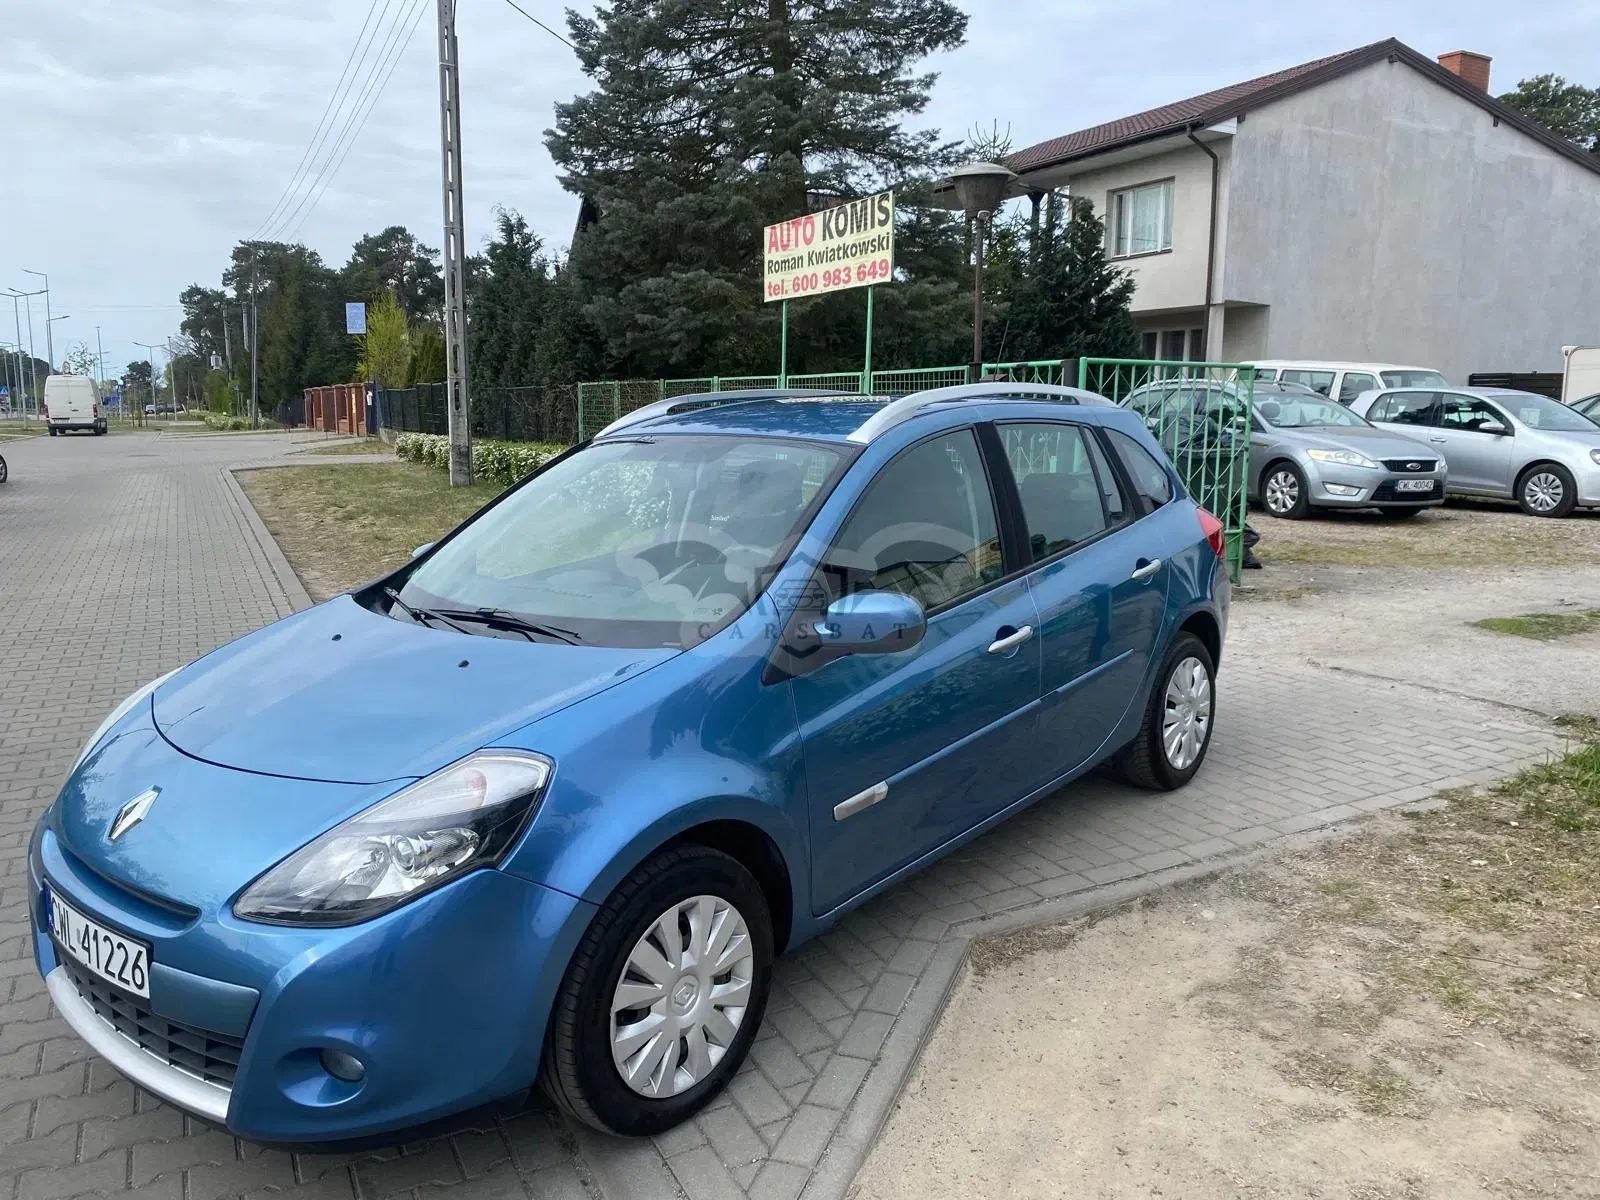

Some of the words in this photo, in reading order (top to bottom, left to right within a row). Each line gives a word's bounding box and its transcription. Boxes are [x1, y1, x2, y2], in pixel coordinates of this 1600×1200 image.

[768, 216, 815, 254] AUTO
[822, 193, 890, 242] KOMIS
[767, 254, 804, 275] Roman
[807, 232, 890, 267] Kwiatkowski
[768, 279, 789, 297] tel.
[792, 273, 818, 293] 600
[822, 266, 852, 288] 983
[856, 258, 890, 282] 649
[81, 923, 145, 991] 41226
